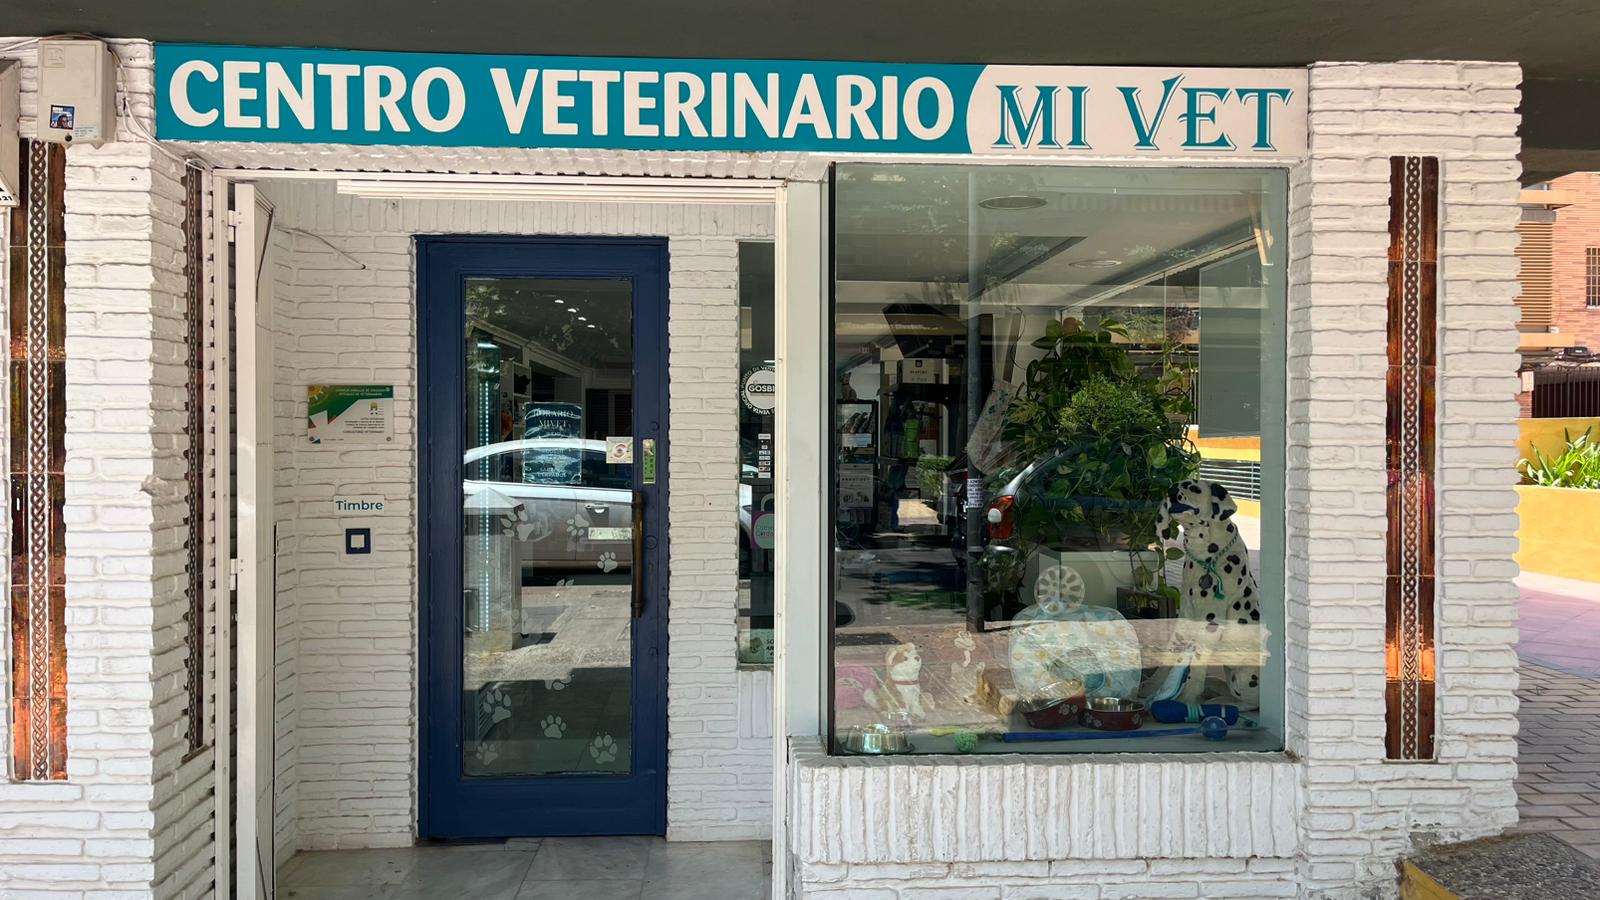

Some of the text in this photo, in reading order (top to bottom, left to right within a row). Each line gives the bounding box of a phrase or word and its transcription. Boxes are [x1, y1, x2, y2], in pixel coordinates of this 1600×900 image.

[169, 60, 1294, 152] CENTRO VETERINARIO MI VET
[335, 499, 384, 511] Timbre
